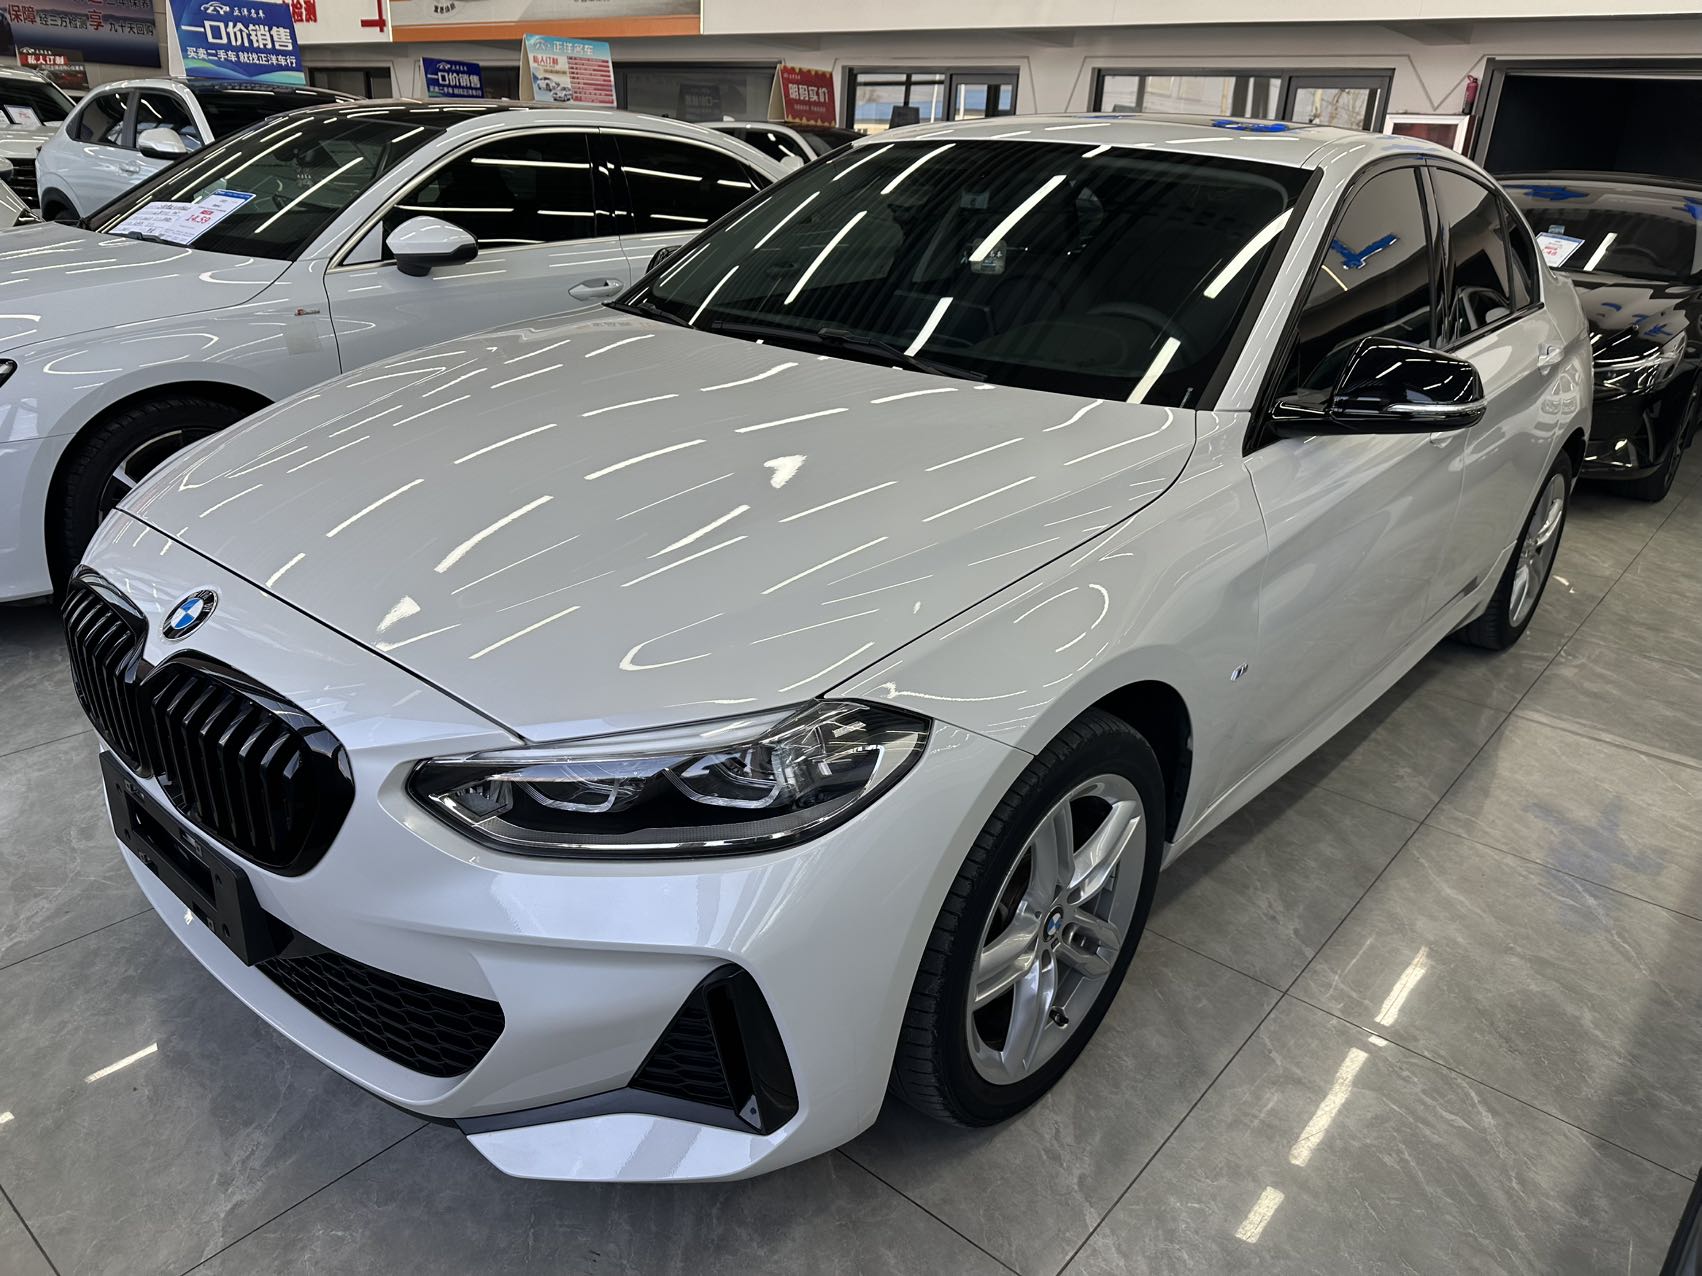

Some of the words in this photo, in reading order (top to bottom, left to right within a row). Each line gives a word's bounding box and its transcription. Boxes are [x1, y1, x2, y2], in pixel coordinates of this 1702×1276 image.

[7, 4, 37, 25] 保障
[181, 20, 293, 50] 一口价销售
[186, 46, 238, 62] 买卖二手车
[239, 51, 296, 67] 就找正洋车行
